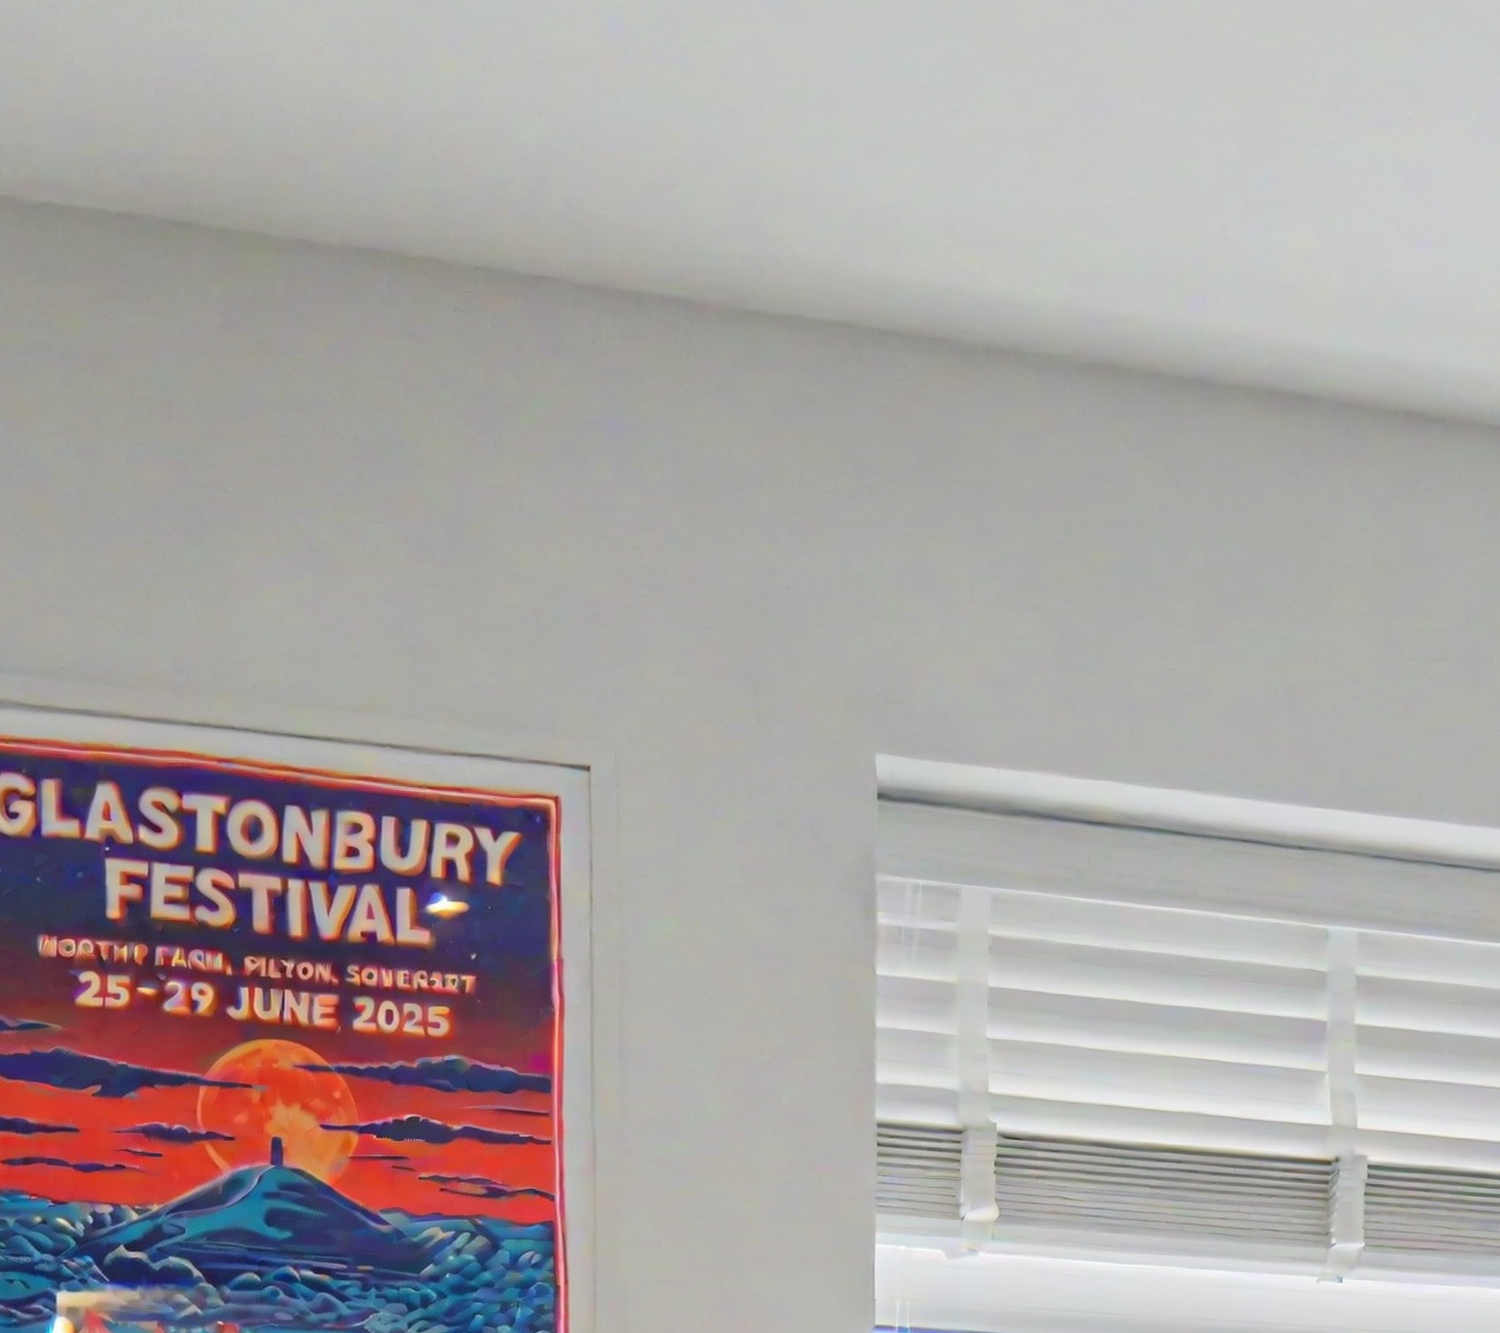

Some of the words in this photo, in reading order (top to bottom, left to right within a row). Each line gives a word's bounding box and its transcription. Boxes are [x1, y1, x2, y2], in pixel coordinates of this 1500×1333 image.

[104, 858, 435, 945] FESTIVAL
[226, 985, 340, 1030] JUNE
[352, 996, 452, 1038] 2025
